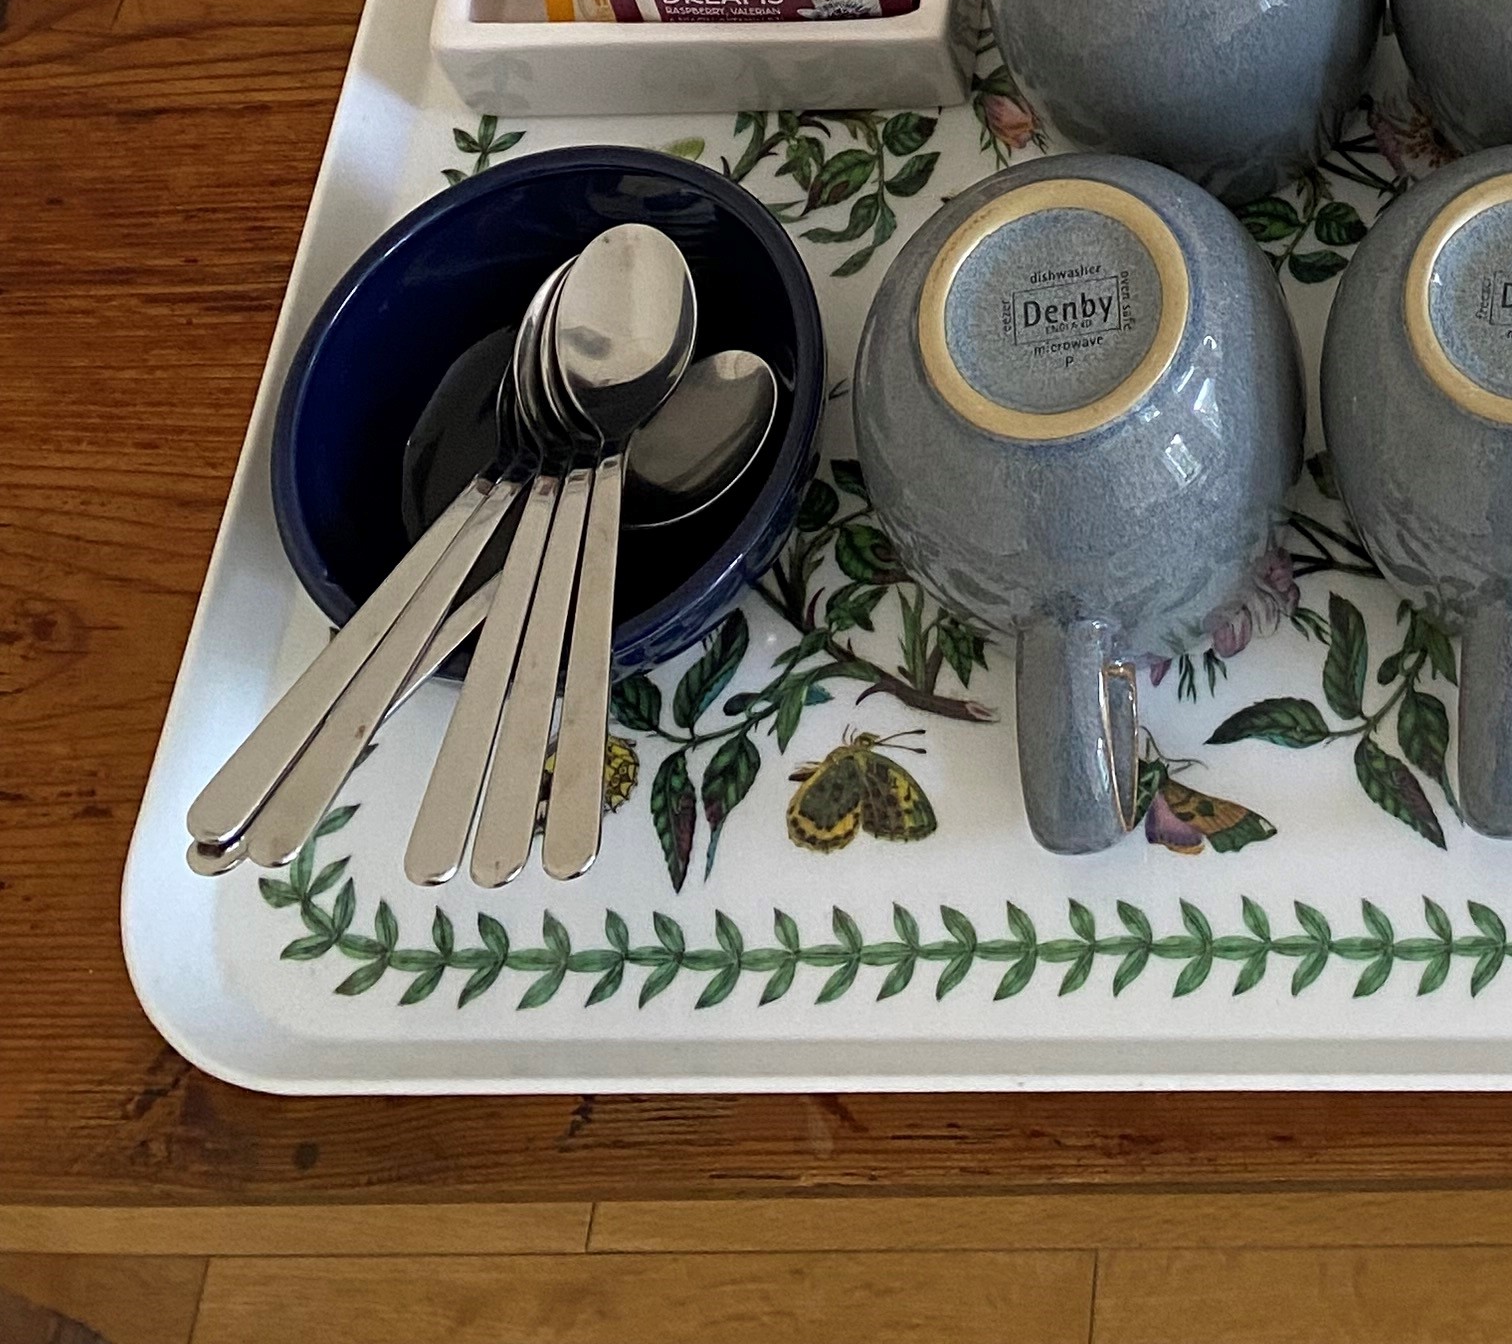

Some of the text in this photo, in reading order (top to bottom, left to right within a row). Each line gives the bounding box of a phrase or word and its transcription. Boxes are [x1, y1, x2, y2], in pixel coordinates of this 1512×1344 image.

[730, 6, 782, 16] VALERIAN
[1030, 264, 1102, 284] dishwasher
[1023, 292, 1113, 328] Denby
[1120, 270, 1136, 331] oven safe
[1034, 335, 1104, 356] microwave
